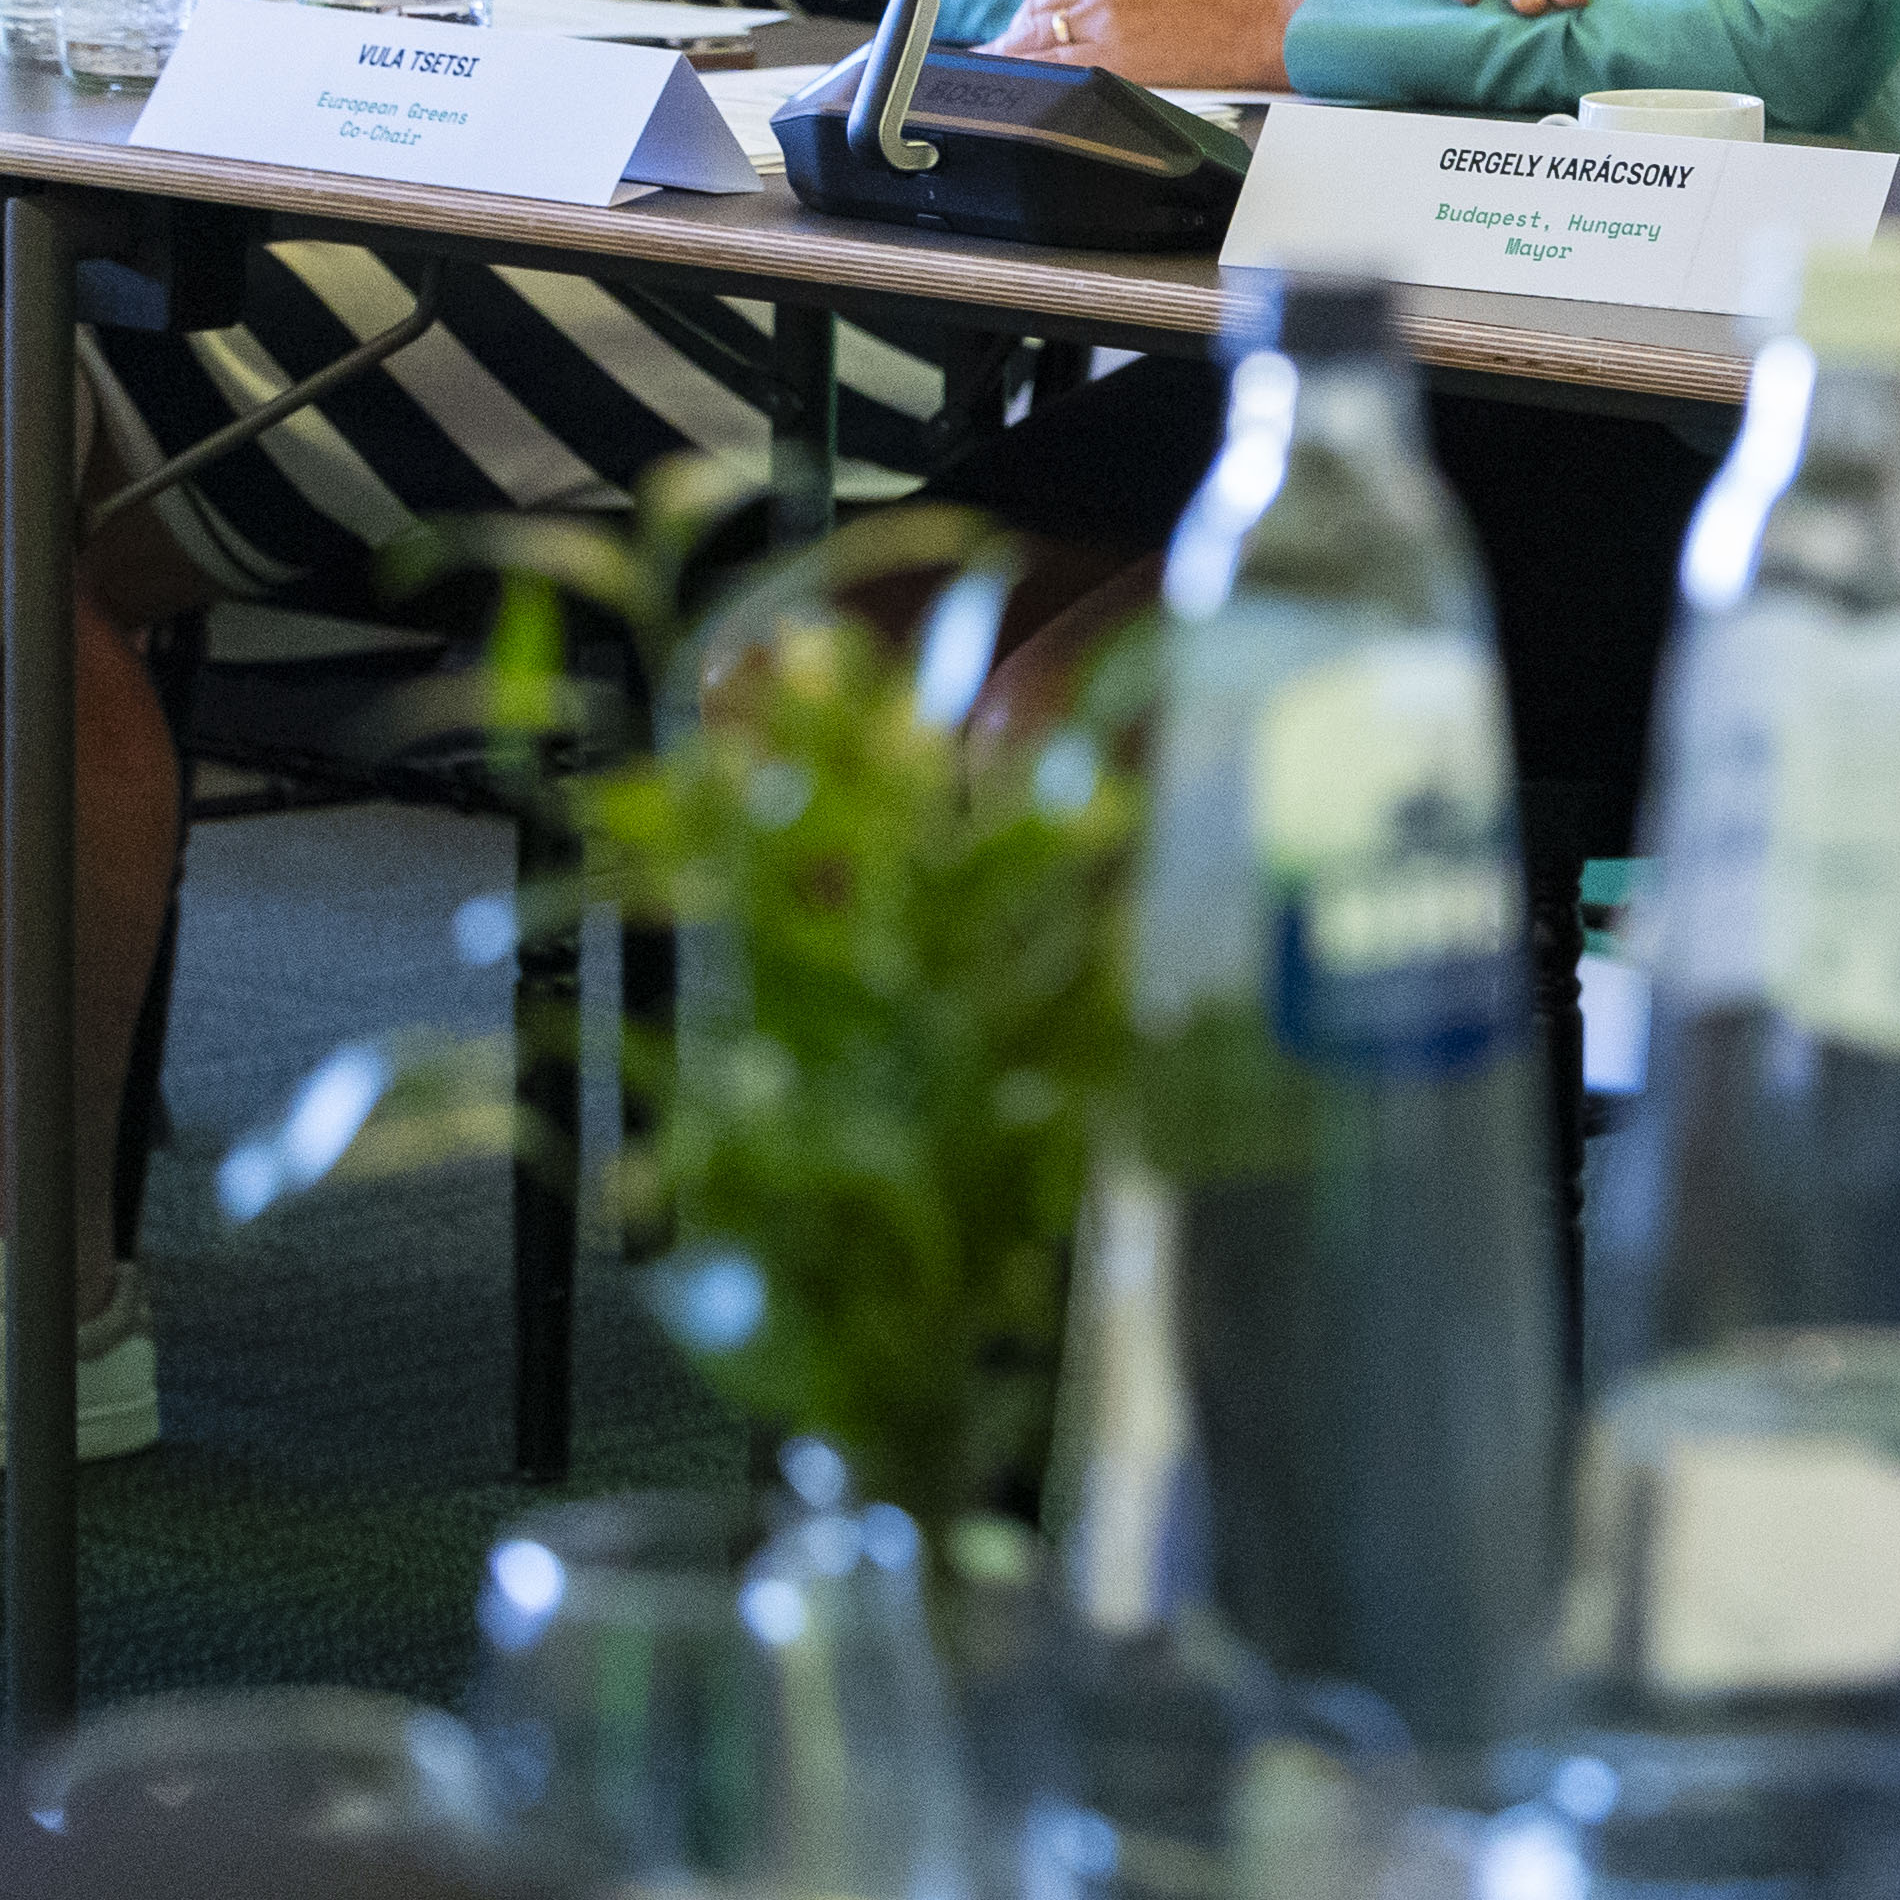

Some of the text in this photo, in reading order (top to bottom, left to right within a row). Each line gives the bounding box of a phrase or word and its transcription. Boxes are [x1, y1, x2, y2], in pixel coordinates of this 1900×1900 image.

[358, 44, 480, 79] VULA TSETSI
[317, 91, 469, 126] European Greens
[339, 121, 422, 146] Co-Chair
[1438, 148, 1695, 189] GERGELY KARÁCSONY
[1435, 202, 1662, 243] Budapest, Hungary
[1504, 237, 1573, 262] Mayor
